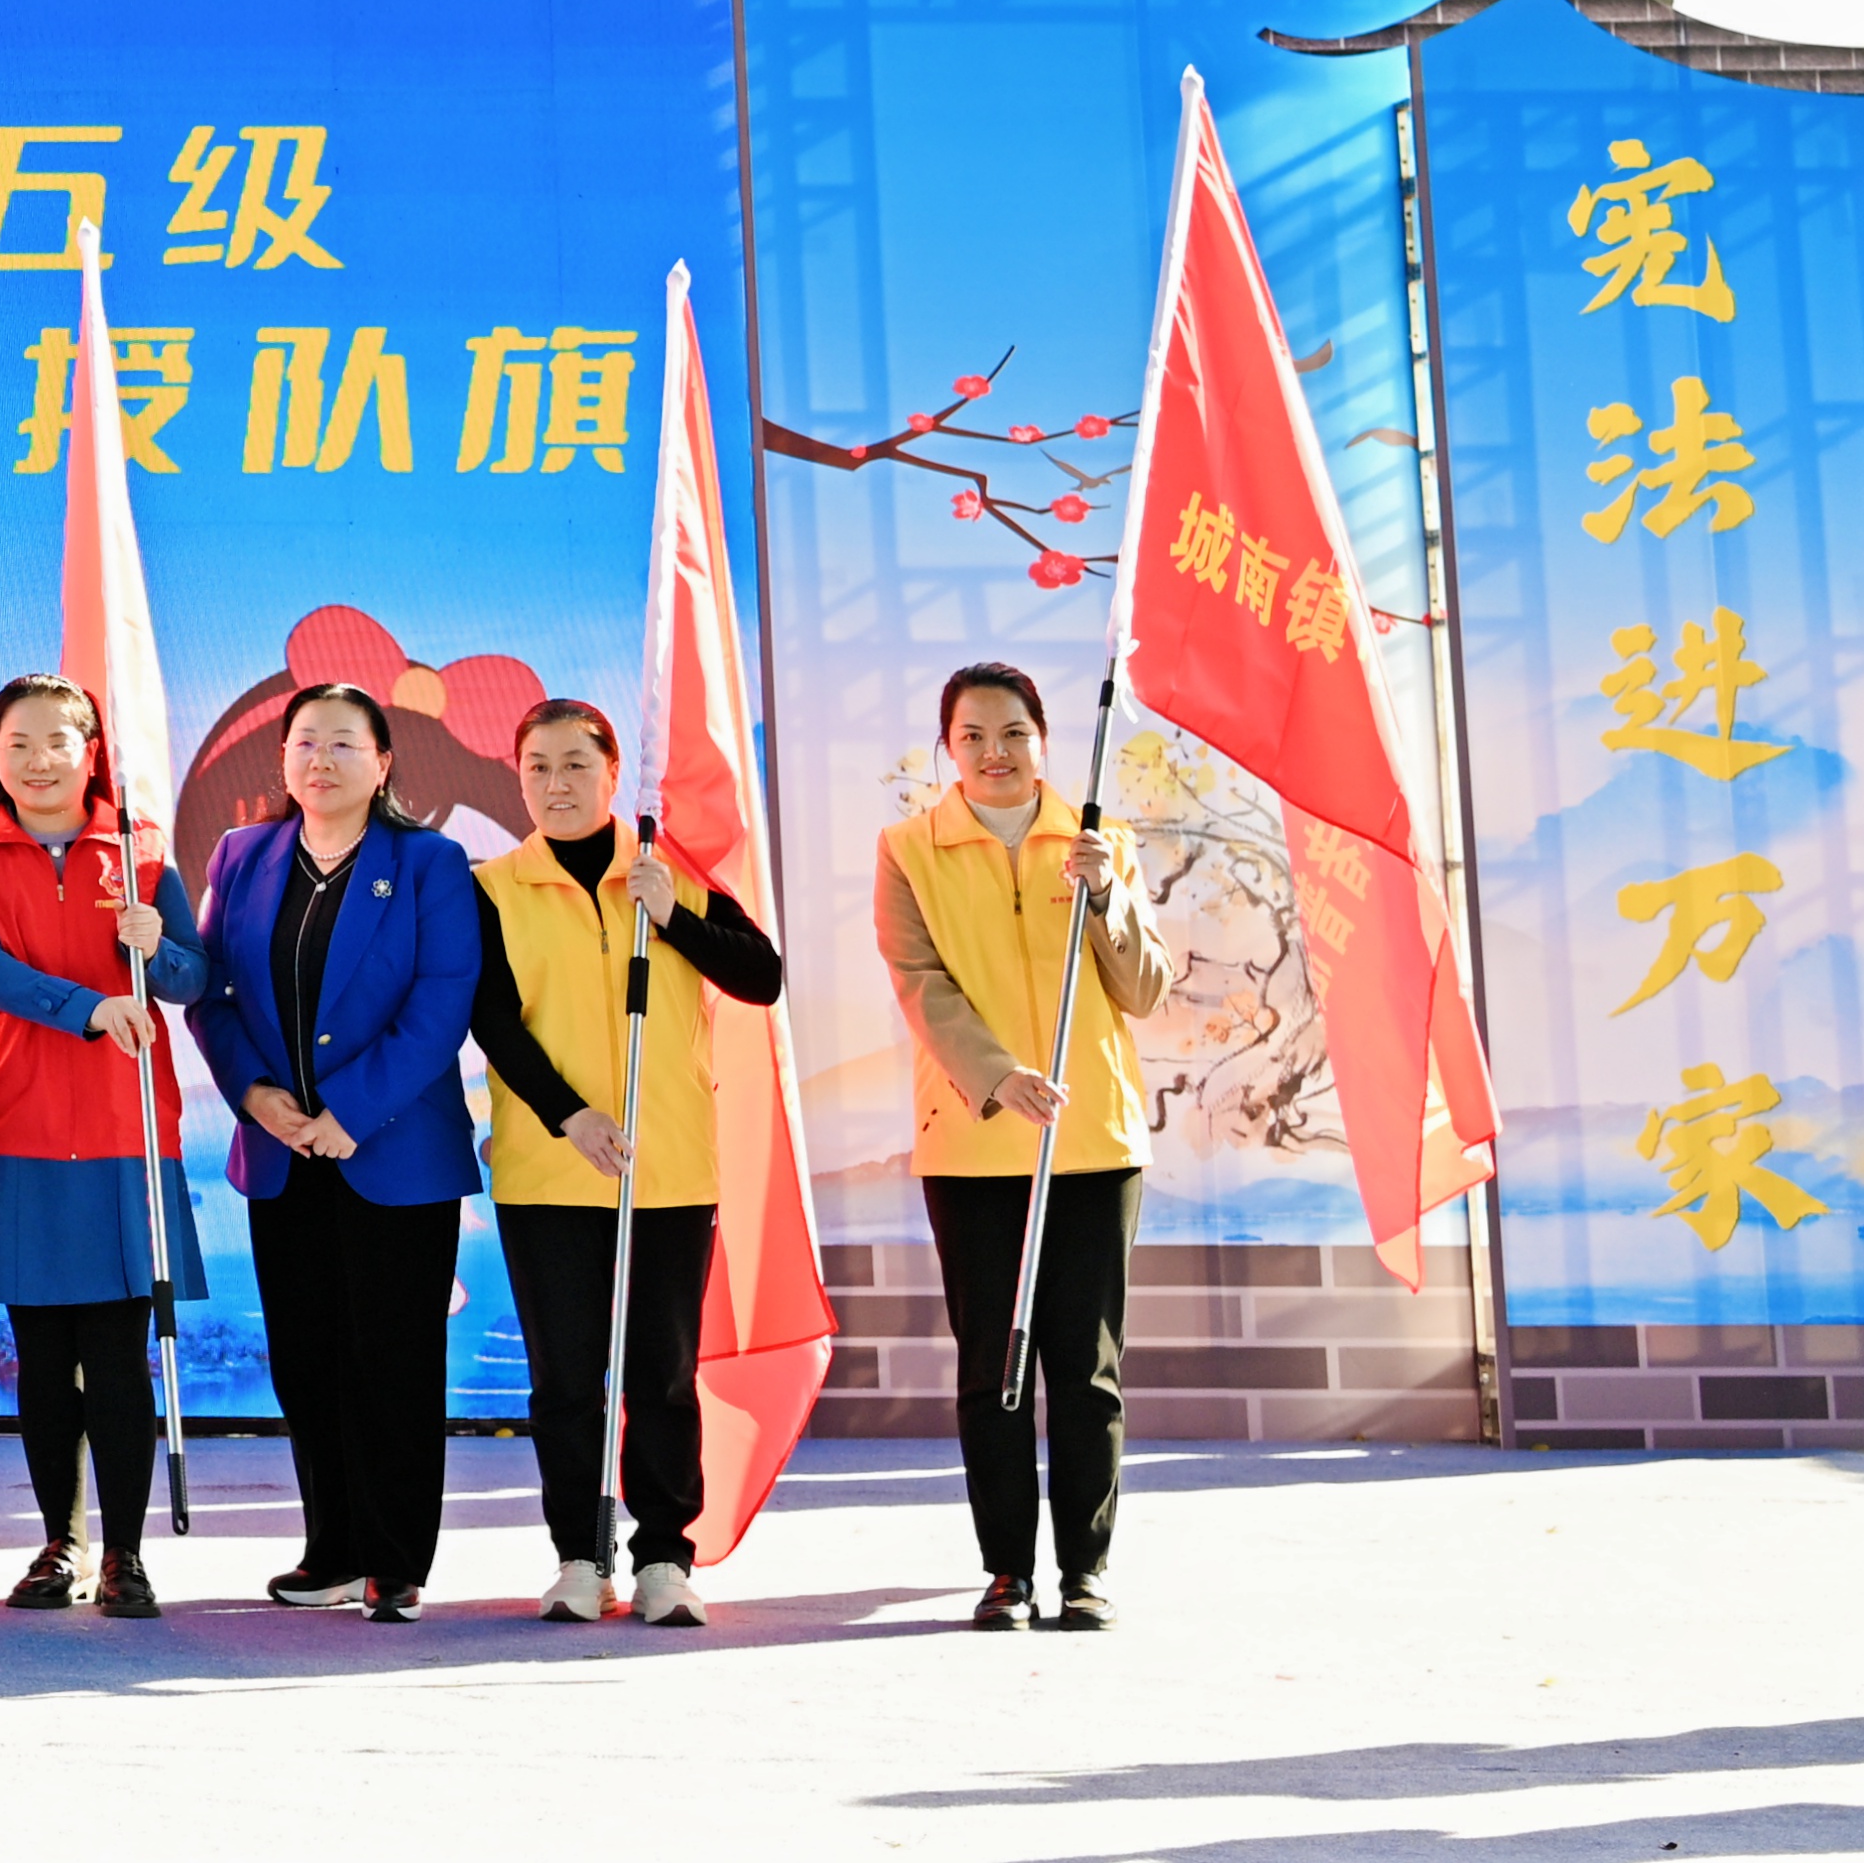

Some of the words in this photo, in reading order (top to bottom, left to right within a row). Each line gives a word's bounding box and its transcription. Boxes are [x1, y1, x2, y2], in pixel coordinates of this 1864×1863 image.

[1169, 490, 1352, 665] 城南镇
[1568, 140, 1829, 1251] 宪法进万家
